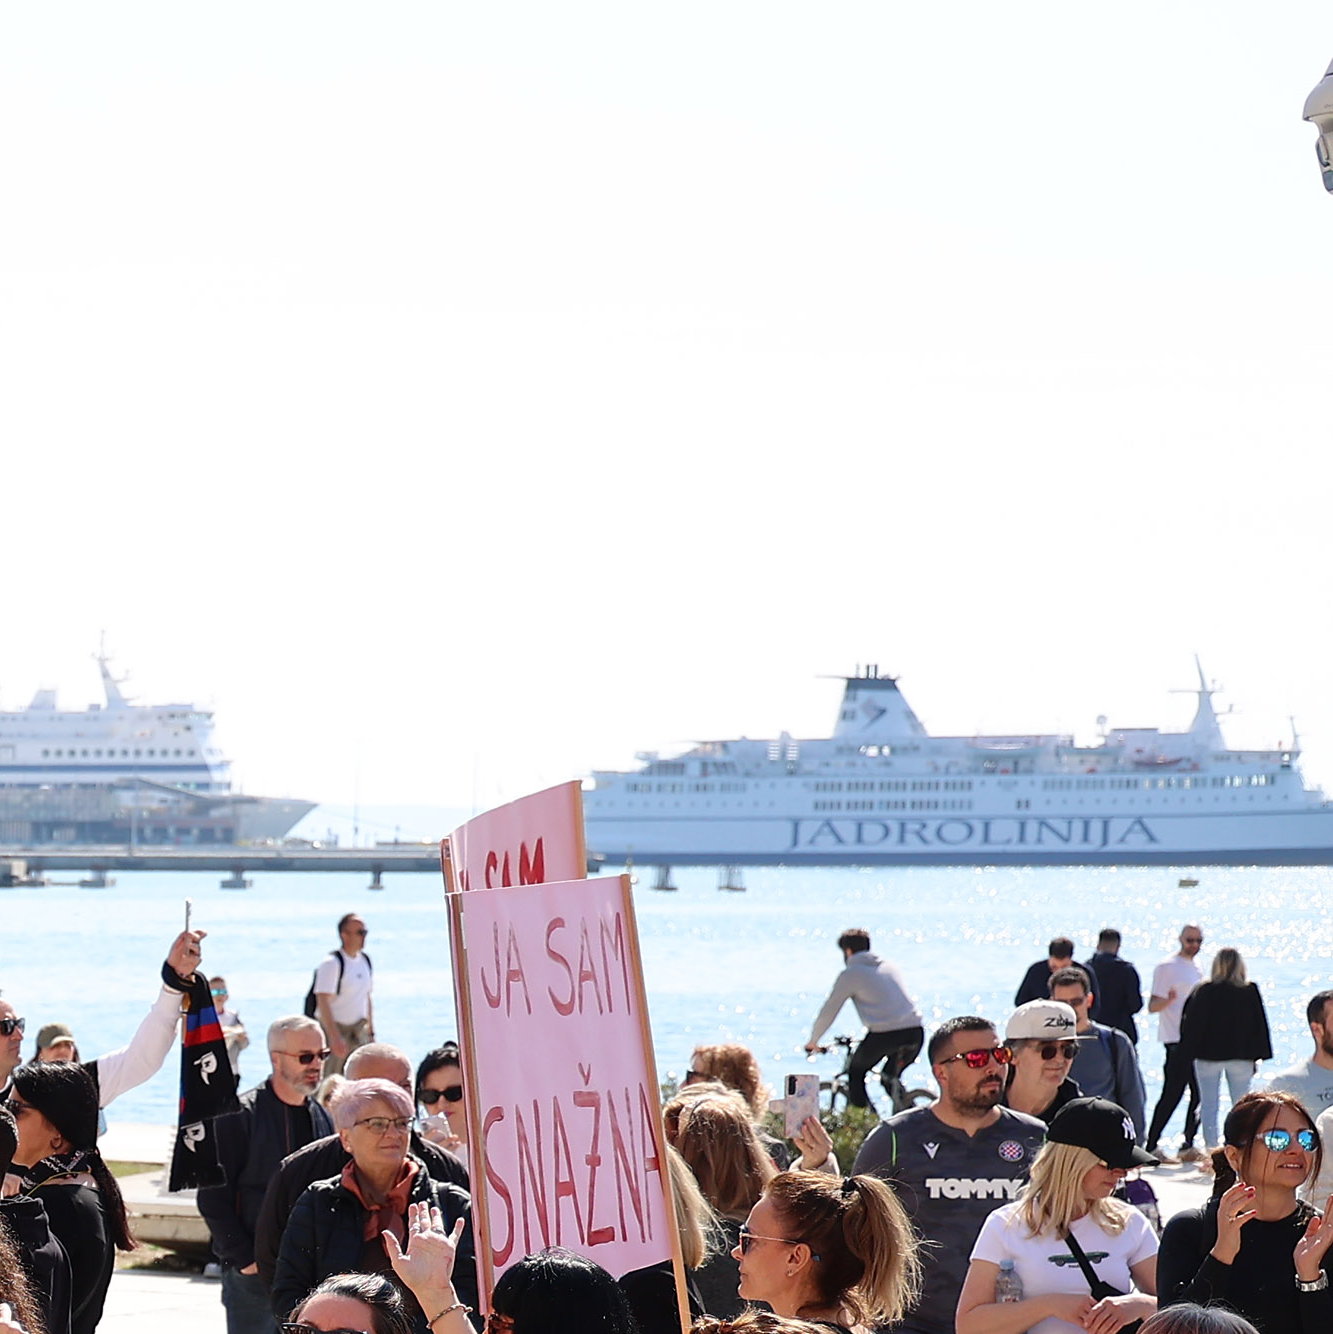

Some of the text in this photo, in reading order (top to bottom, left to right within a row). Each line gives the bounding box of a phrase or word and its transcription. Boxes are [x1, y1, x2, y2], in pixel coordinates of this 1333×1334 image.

[787, 815, 1160, 850] JADROLINIJA
[481, 912, 631, 1018] JA SAM
[484, 1062, 665, 1268] SNAŽNA
[925, 1178, 1024, 1199] TOMMY
